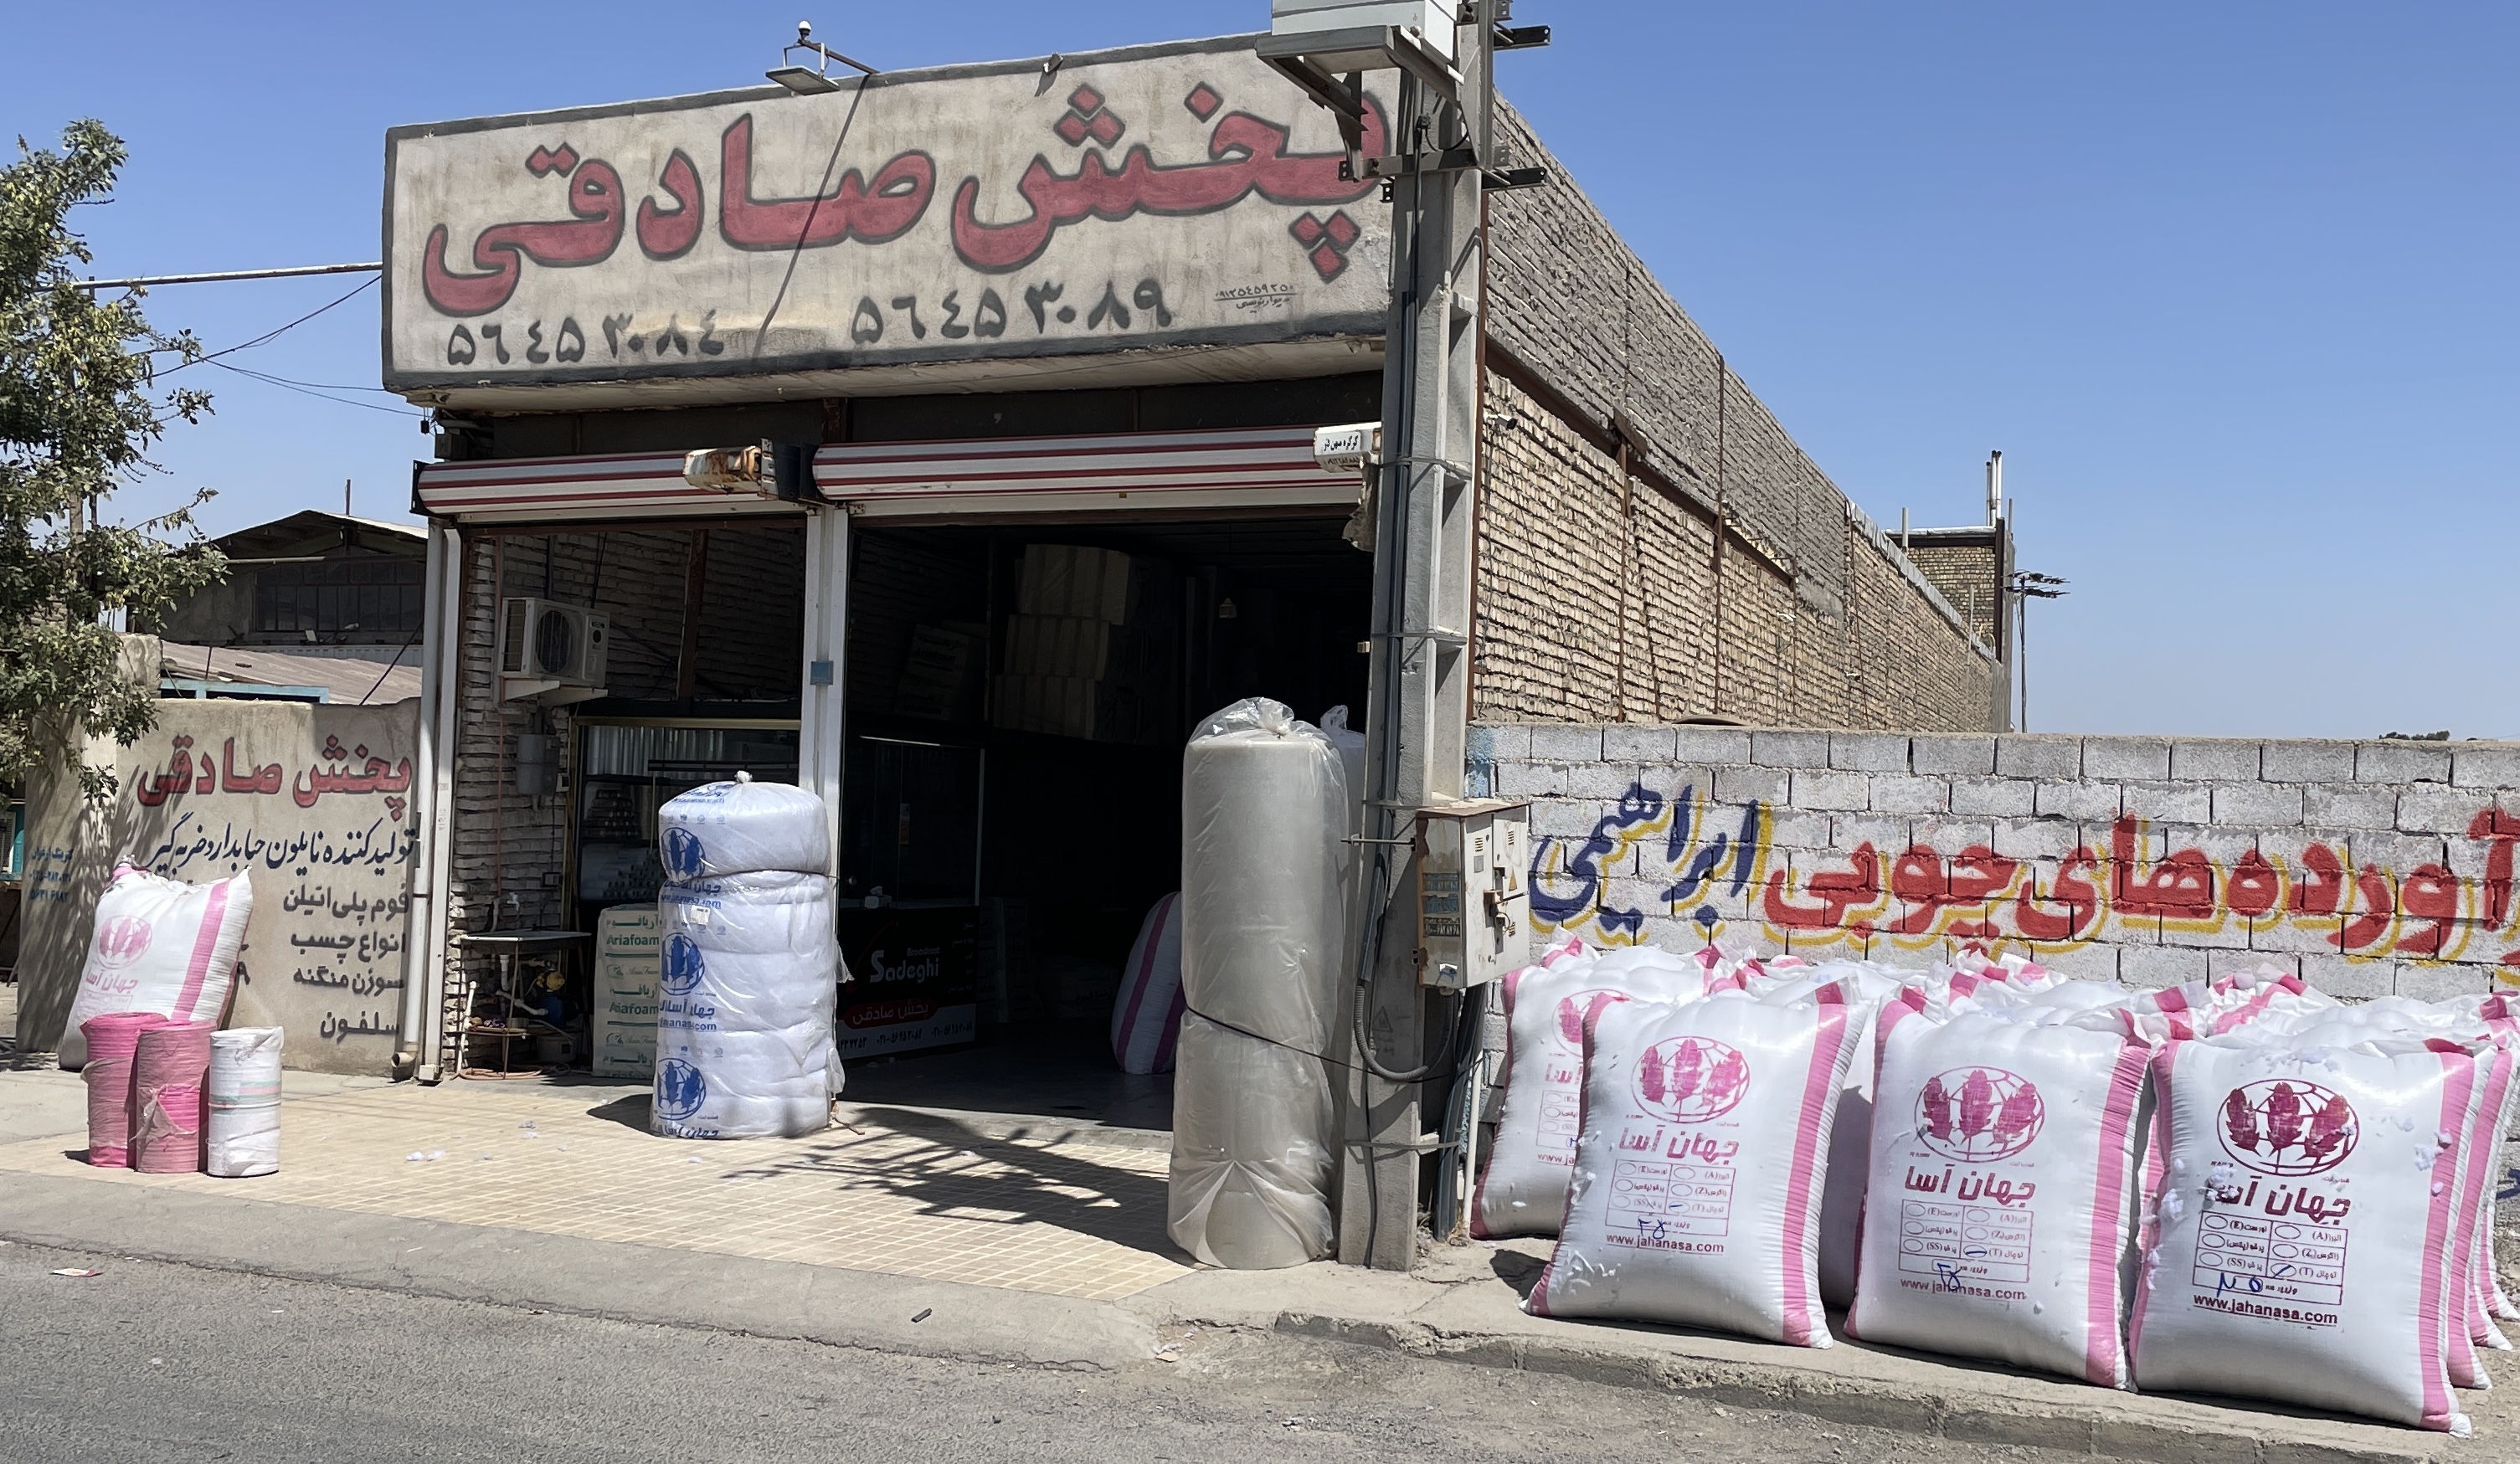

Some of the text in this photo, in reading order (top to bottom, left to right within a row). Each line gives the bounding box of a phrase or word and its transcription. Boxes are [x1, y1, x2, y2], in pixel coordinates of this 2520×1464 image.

[423, 81, 1391, 316] پخش صادقی
[137, 734, 412, 821] پخش صادقی
[1528, 782, 1761, 932] ابراهیمی
[283, 884, 332, 916] اتیلن
[332, 891, 368, 926] پلی
[1764, 841, 2017, 956] چوبی
[291, 931, 406, 964] انواع چسب
[606, 933, 660, 946] Ariafoam
[352, 968, 404, 997] سوزن
[870, 949, 939, 983] Sadeghi
[320, 1010, 399, 1045] سلفون
[852, 1005, 894, 1025] صادقی
[1618, 1124, 1740, 1165] جهان آسا
[1905, 1163, 2036, 1208] جهان آسا
[2264, 1184, 2352, 1225] جهان
[1606, 1234, 1725, 1254] www.jahanasa.com
[2193, 1294, 2338, 1324] www.jahanasa.com
